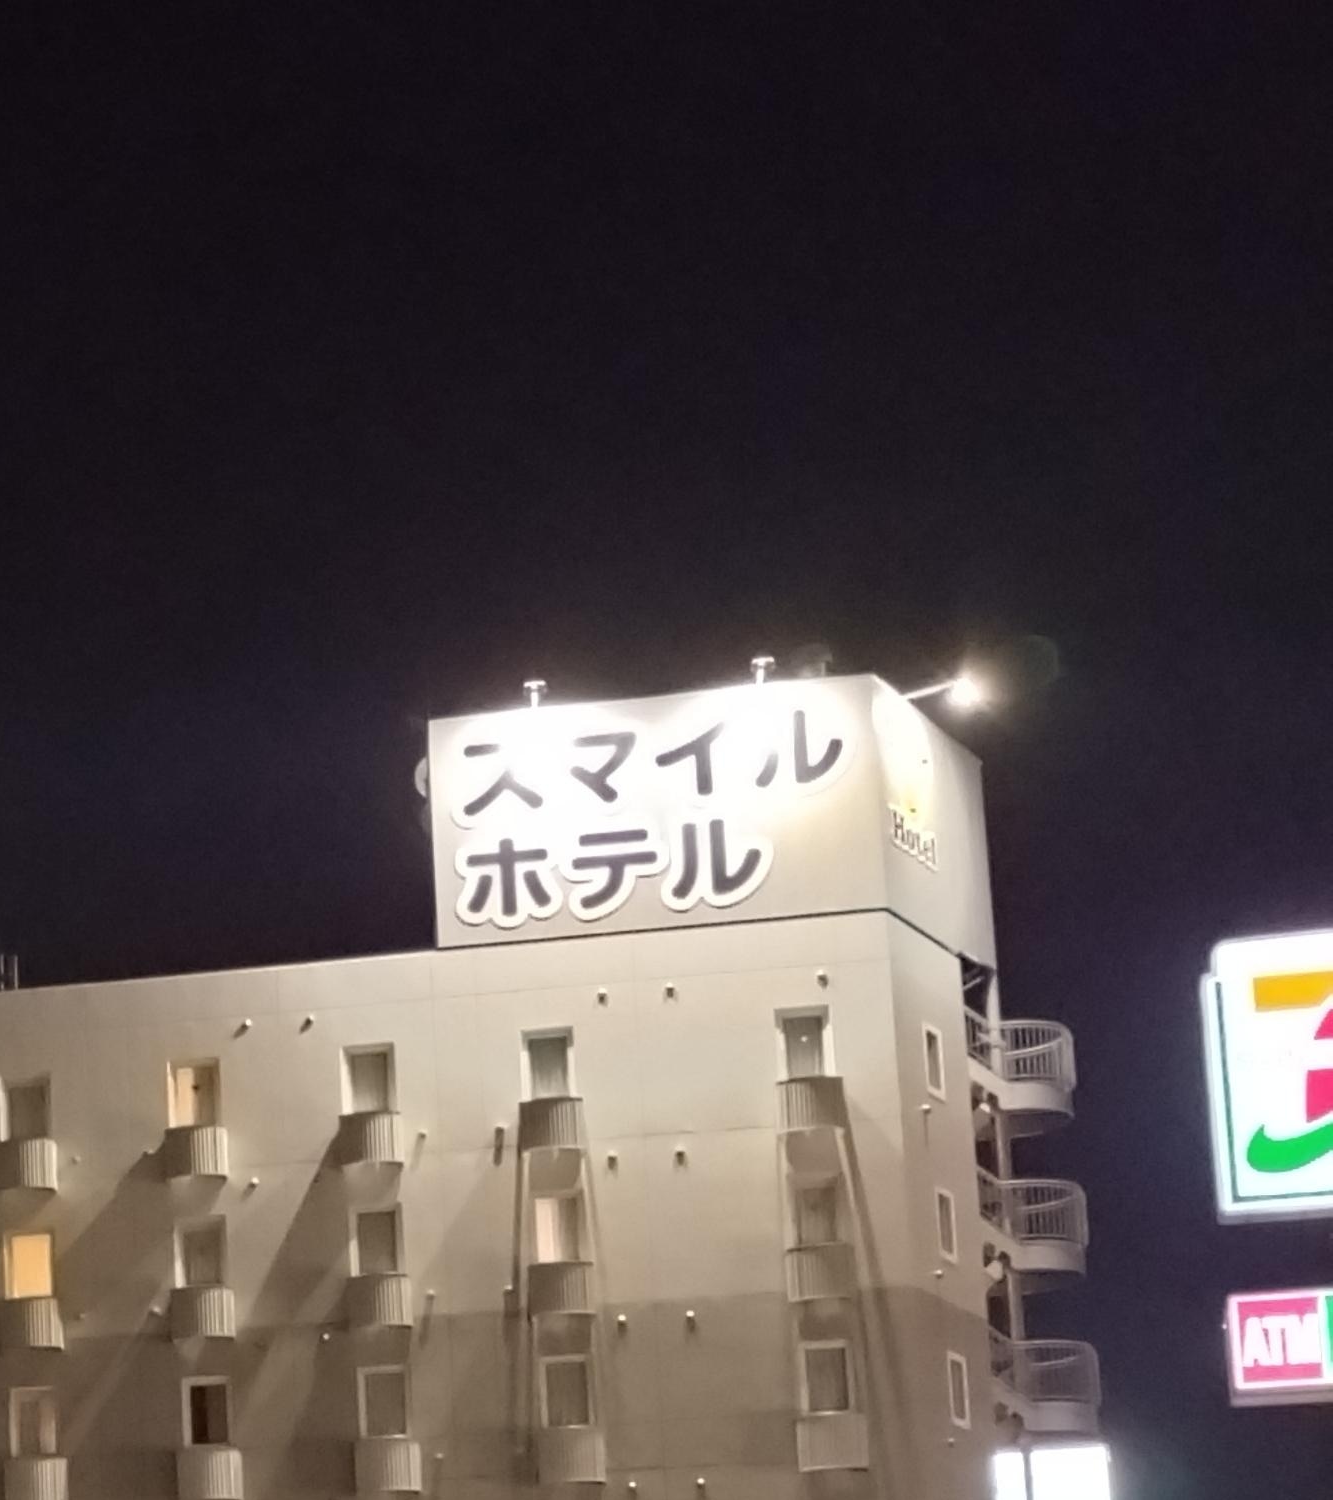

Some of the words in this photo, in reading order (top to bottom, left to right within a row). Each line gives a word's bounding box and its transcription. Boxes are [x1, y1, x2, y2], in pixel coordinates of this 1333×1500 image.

[463, 709, 843, 817] スマイル
[466, 818, 762, 917] ホテル
[892, 810, 937, 865] Hotel
[1243, 1312, 1323, 1368] ATM
